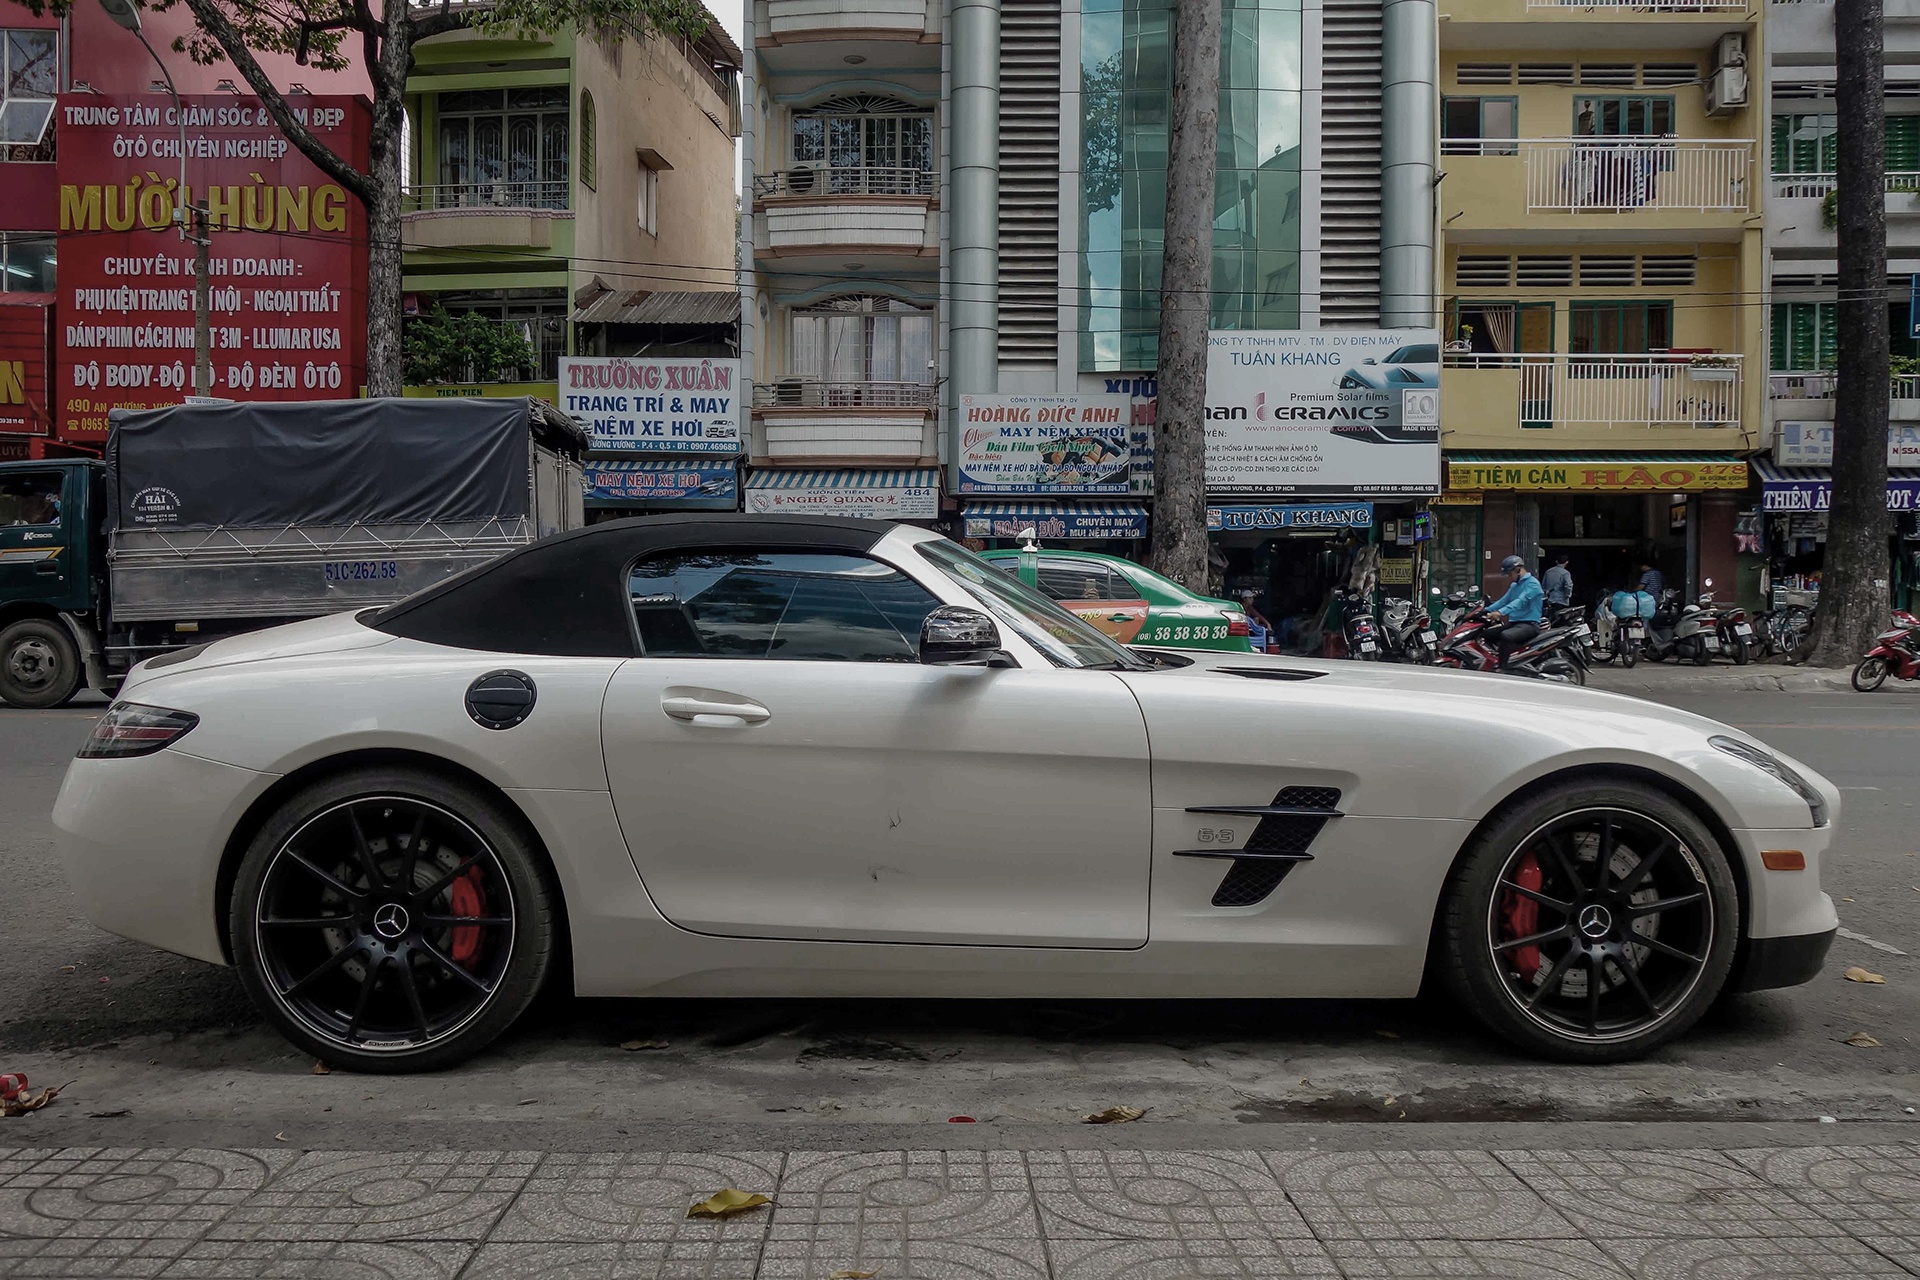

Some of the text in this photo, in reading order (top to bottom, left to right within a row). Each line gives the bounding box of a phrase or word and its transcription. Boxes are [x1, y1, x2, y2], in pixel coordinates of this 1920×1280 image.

[64, 106, 120, 126] TRUNG
[123, 102, 160, 126] TÂM
[165, 104, 214, 126] CHĂM
[218, 102, 252, 126] SÓC
[256, 107, 269, 126] &
[313, 107, 345, 131] ĐẸP
[113, 134, 288, 162] ÔTÔ CHUYÊN NGHIỆP
[60, 171, 346, 232] MƯỜI HÙNG
[104, 253, 180, 275] CHUYÊN
[184, 258, 228, 275] KNH
[75, 281, 341, 316] PHỤ KIỆN TRANG TÍ NỘI NGOẠI THẤT
[66, 320, 341, 349] DÁN PHIM CÁCH NHT 3M LLUMAR USA
[1231, 337, 1244, 346] TY
[1247, 337, 1276, 346] TNHH
[1278, 337, 1301, 346] MTV
[1309, 337, 1325, 346] TM
[1333, 336, 1349, 346] DV
[1350, 335, 1378, 347] ĐIỆN
[1281, 352, 1341, 366] KHANG
[74, 360, 100, 391] ĐỘ
[228, 360, 255, 392] ĐỘ
[259, 360, 297, 389] ĐÈN
[303, 360, 342, 389] ÔTÔ
[567, 358, 734, 391] TRƯỜNG XUÂN
[66, 398, 108, 413] 490 AN
[566, 393, 731, 414] TRANG TRÍ & MAY
[1290, 392, 1390, 401] Premium Solar films
[1407, 395, 1435, 415] 10
[967, 404, 1031, 423] HOÀNG
[1037, 404, 1077, 423] ĐỨC
[1081, 407, 1120, 423] ANH
[81, 417, 103, 432] 0965
[593, 415, 703, 439] NỆM XE HƠI
[1000, 427, 1033, 438] MAY
[1037, 424, 1071, 440] NỆM
[1072, 427, 1095, 438] XE
[1099, 425, 1126, 438] HƠI
[592, 440, 611, 449] ƯƠNG
[641, 441, 653, 450] P.4
[659, 442, 671, 450] Q.5
[690, 443, 737, 451] 0907.469688
[985, 441, 1008, 452] Dán
[1010, 441, 1035, 452] Film
[964, 463, 982, 472] MAY
[982, 461, 1001, 473] NỆM
[1002, 463, 1013, 472] XE
[1473, 465, 1522, 487] TIỆM
[1527, 465, 1567, 484] CÁN
[1700, 464, 1747, 475] 478
[595, 471, 701, 490] MAY NỆM XE HƠI
[833, 495, 885, 505] QUANG
[904, 488, 931, 497] 484
[1763, 485, 1813, 510] THIÊN
[1075, 516, 1134, 527] CHUYÊN MAY
[1290, 508, 1370, 525] KHANG
[1088, 528, 1140, 539] NỆM XE HƠI
[325, 561, 397, 581] 51C-262.58
[1137, 625, 1229, 642] (08) 38 38 38 38
